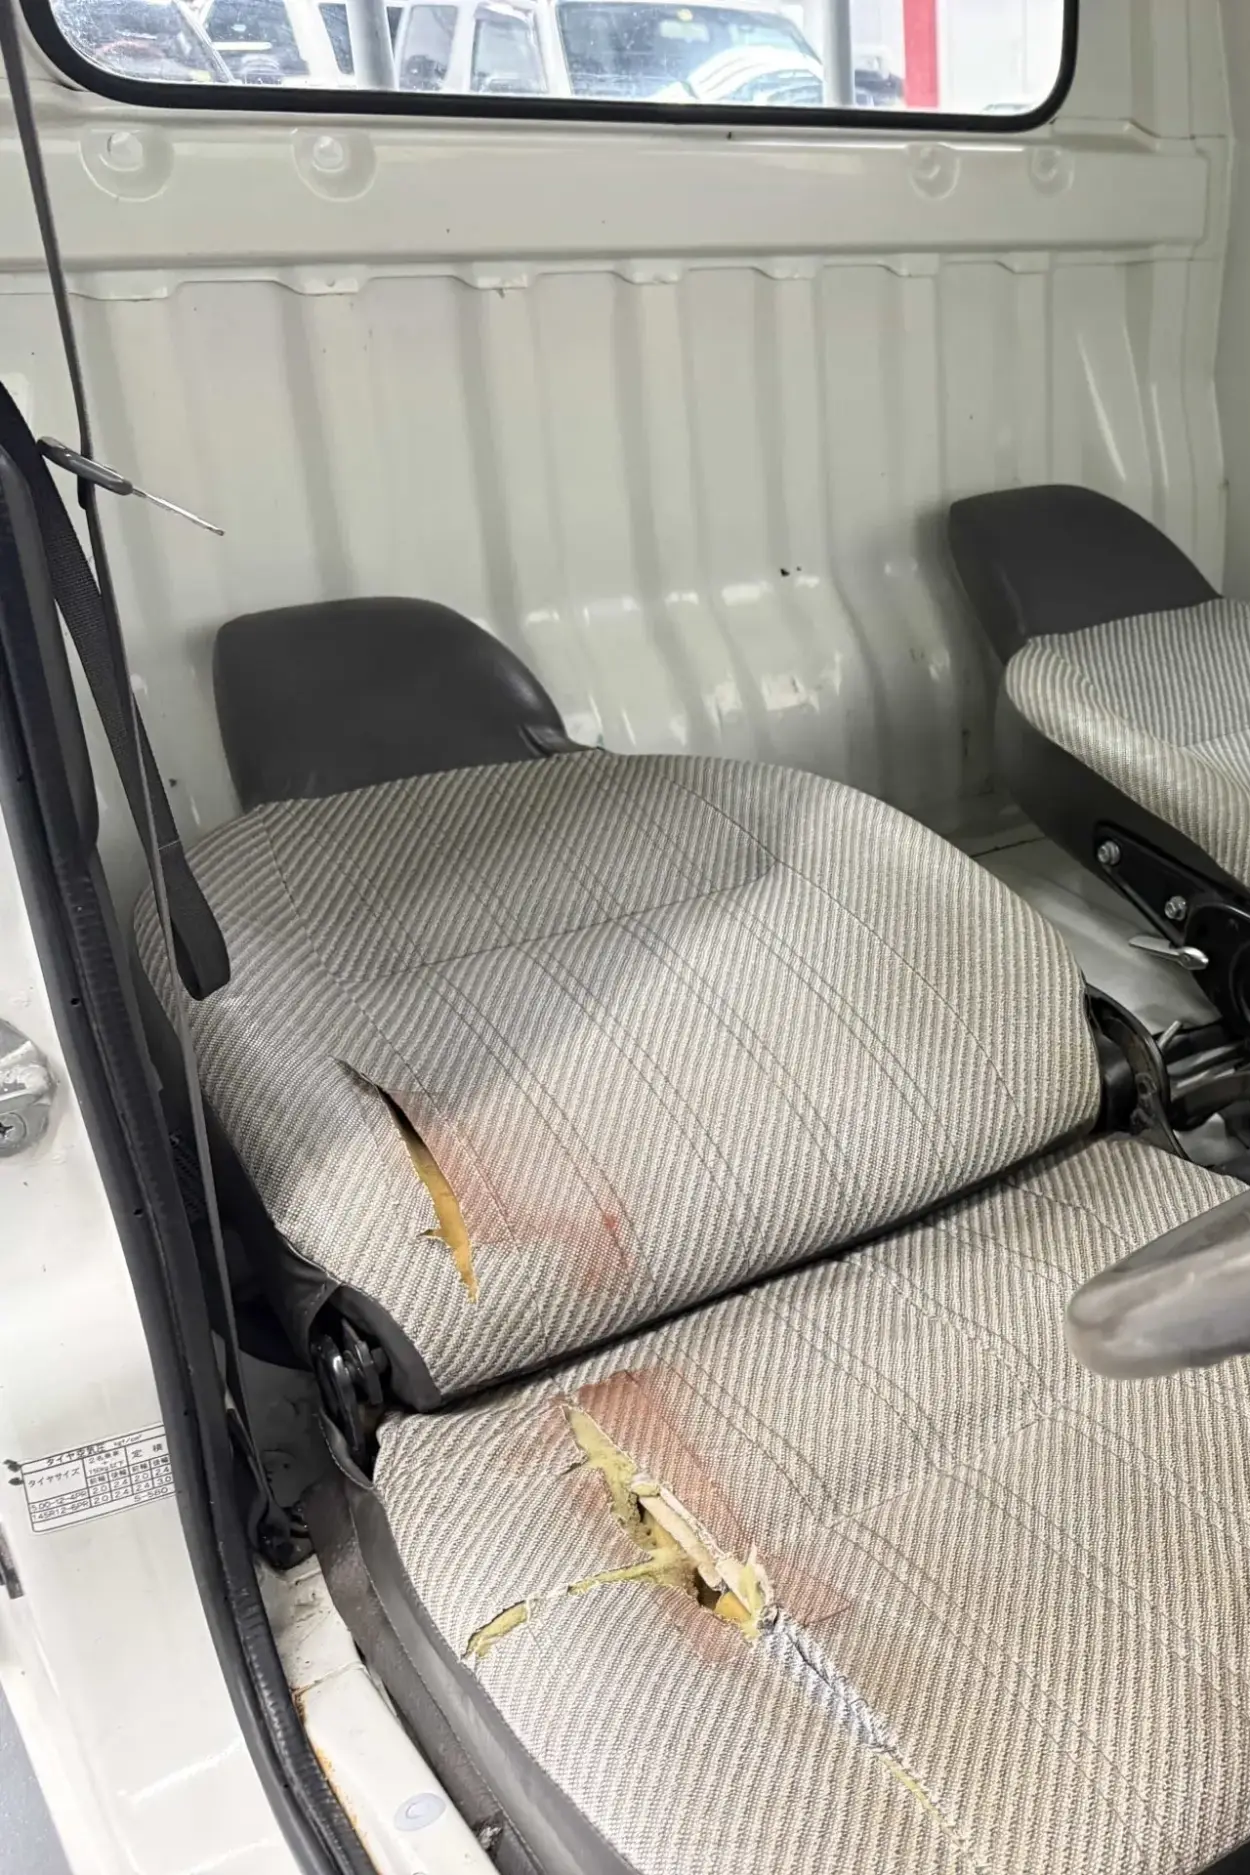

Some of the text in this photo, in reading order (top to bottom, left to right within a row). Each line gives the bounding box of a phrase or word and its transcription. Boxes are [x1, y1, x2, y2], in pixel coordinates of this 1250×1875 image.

[28, 1467, 81, 1489] タイヤサイズ
